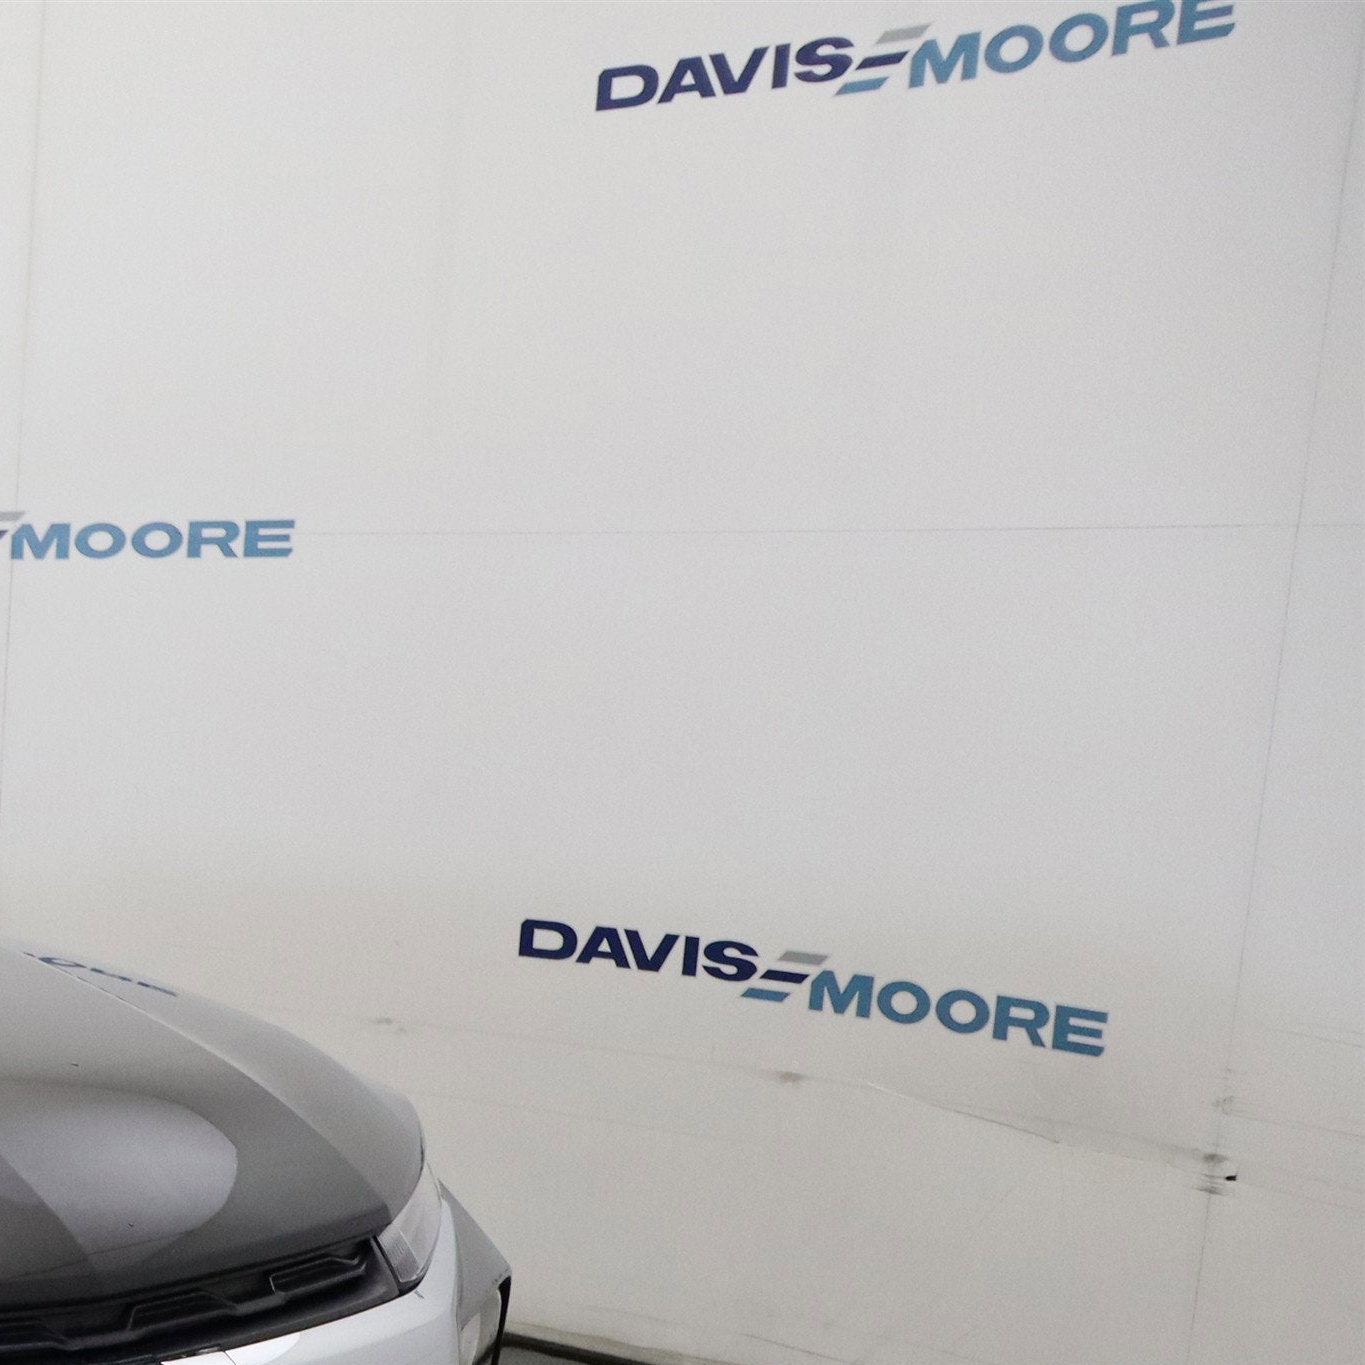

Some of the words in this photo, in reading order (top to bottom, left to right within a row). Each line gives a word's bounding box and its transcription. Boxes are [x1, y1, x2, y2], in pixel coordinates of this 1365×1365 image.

[594, 36, 853, 112] DAVIS
[907, 0, 1237, 88] MOORE
[10, 519, 296, 561] MOORE
[517, 917, 760, 983] DAVIS
[807, 969, 1109, 1058] MOORE
